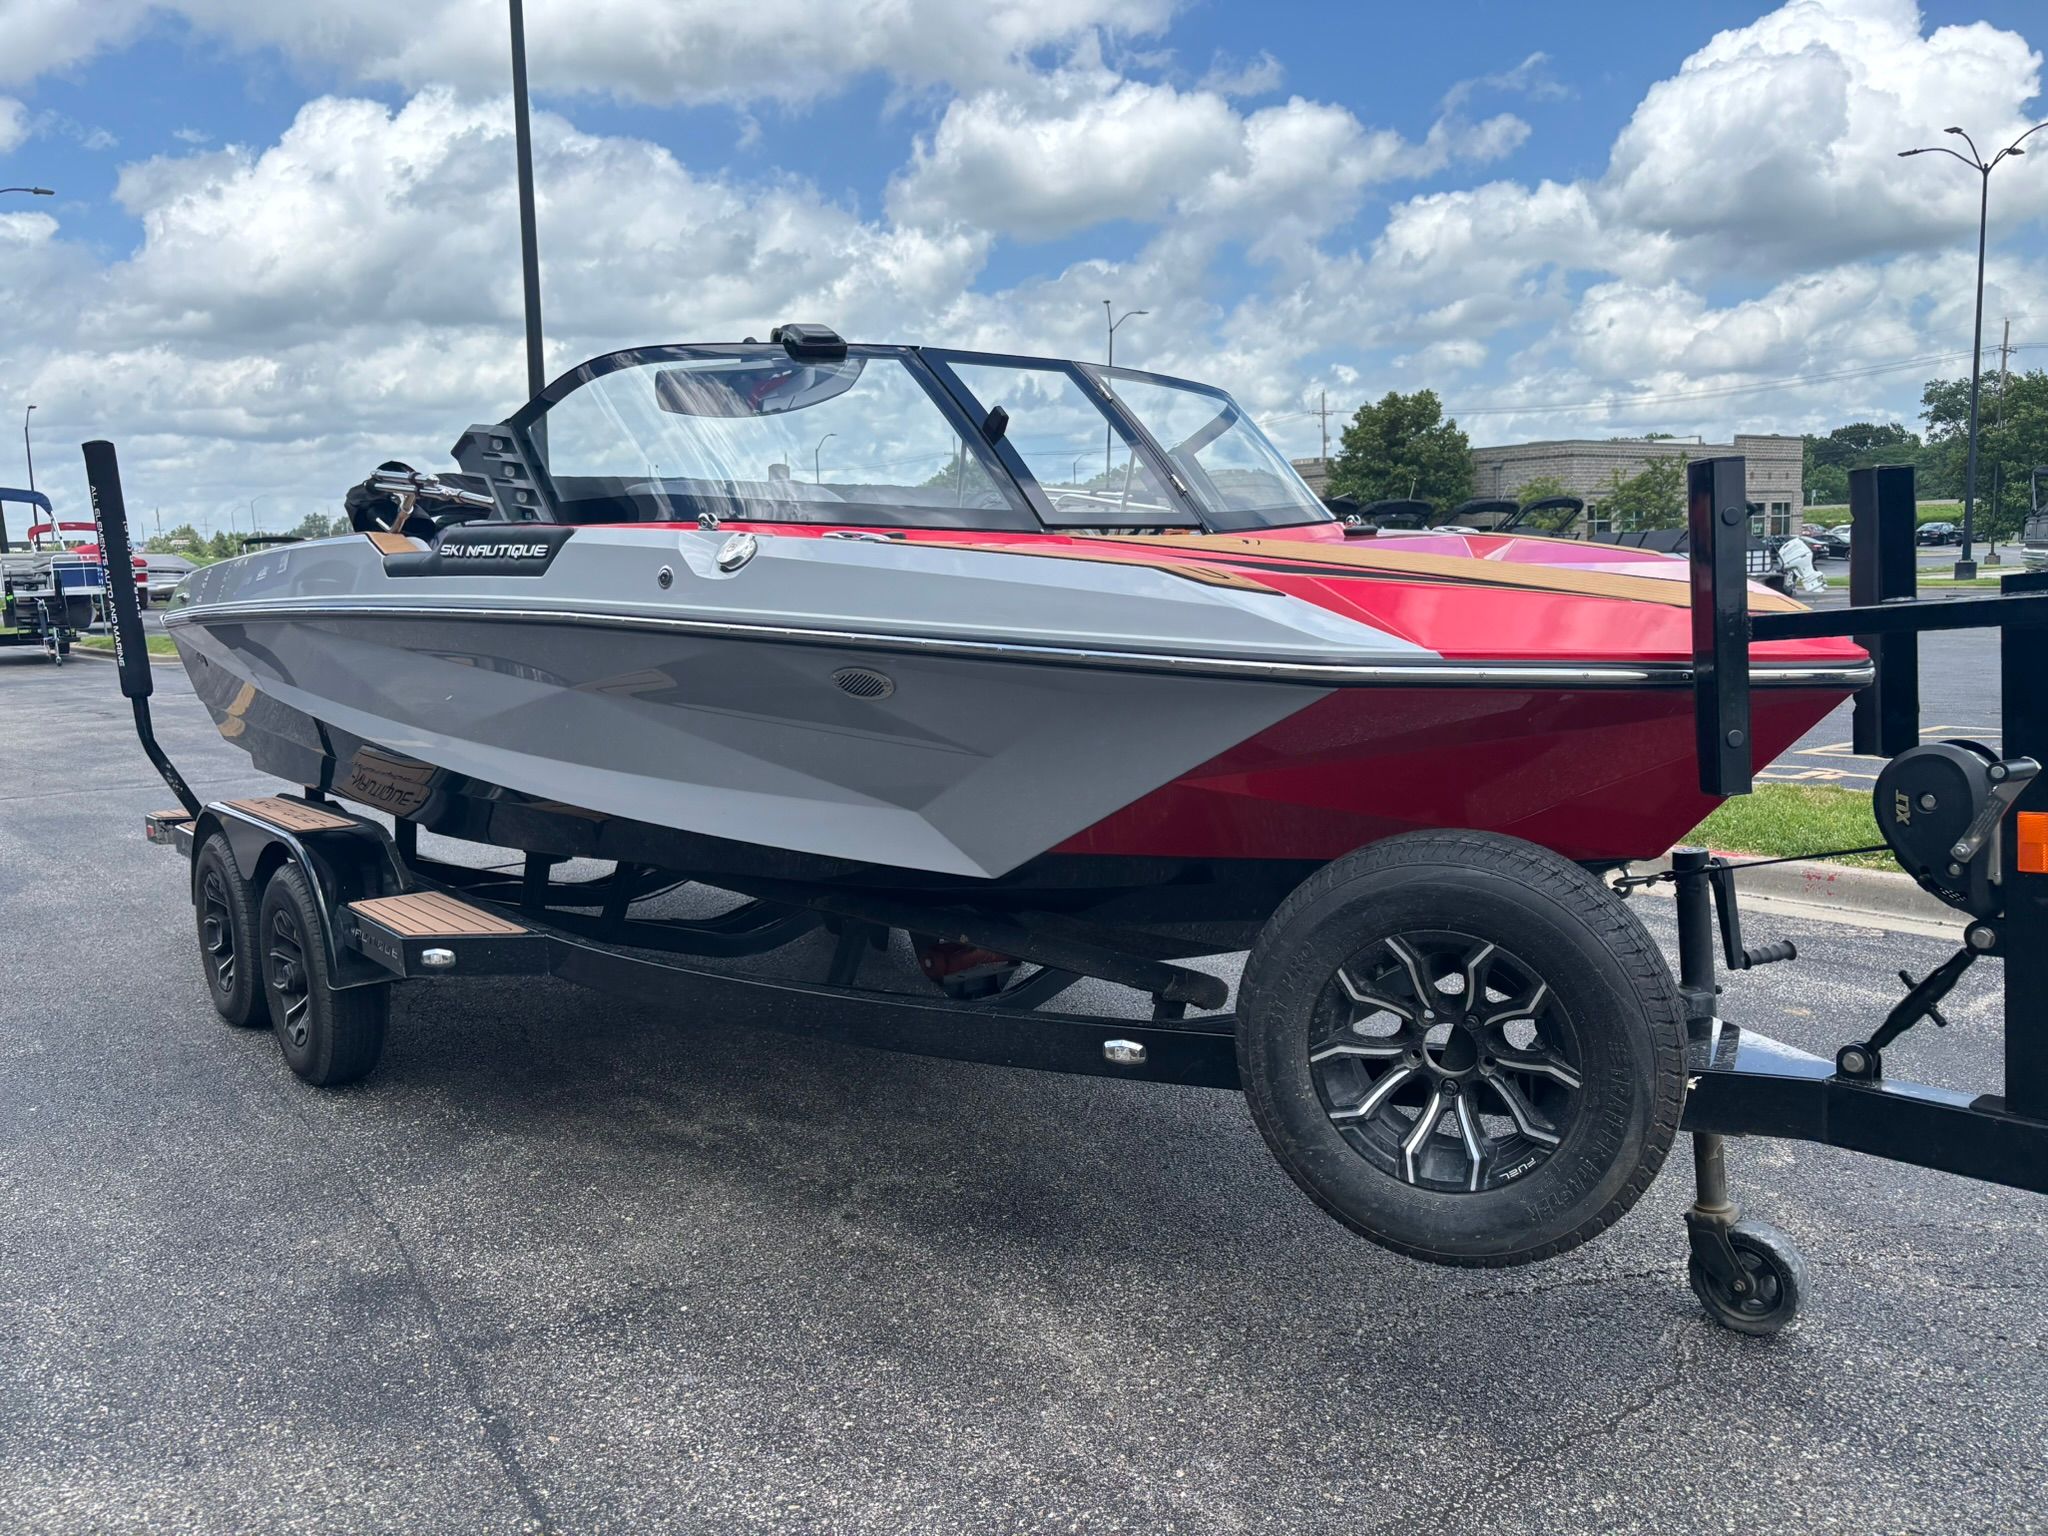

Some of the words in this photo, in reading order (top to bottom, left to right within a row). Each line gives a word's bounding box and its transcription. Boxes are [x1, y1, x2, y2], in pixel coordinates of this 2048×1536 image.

[90, 485, 99, 507] ALL
[94, 508, 109, 567] ELEMENTS
[440, 544, 465, 557] SKI
[466, 544, 548, 559] NAUTIQUE
[104, 567, 114, 600] AUTO
[109, 600, 119, 624] AND
[113, 625, 126, 668] MARINE
[1895, 789, 1911, 826] XLT
[1499, 1157, 1537, 1180] FUEL
